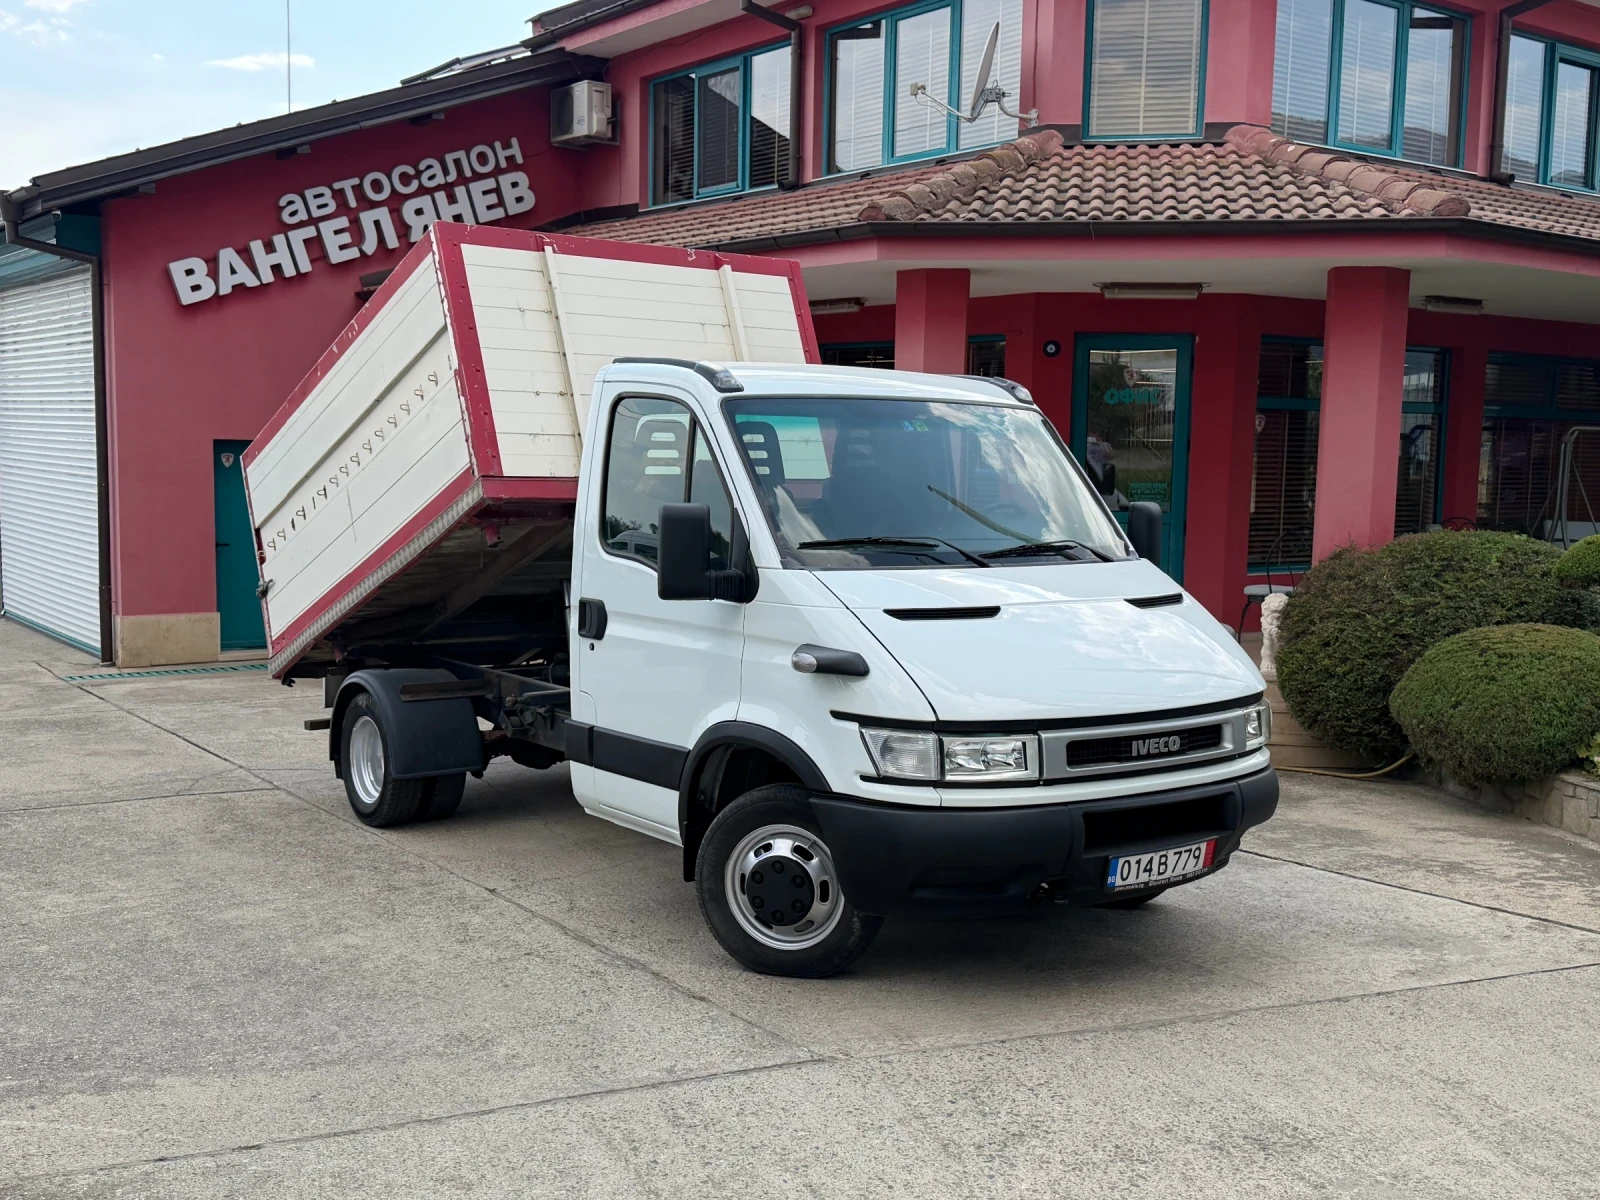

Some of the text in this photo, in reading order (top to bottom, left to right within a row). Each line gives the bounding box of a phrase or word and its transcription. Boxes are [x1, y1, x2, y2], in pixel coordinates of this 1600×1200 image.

[278, 137, 524, 225] автосалон
[166, 171, 536, 306] ВАНГЕЛ ЯНЕВ
[1131, 735, 1181, 757] IVECO
[1107, 876, 1116, 884] BG
